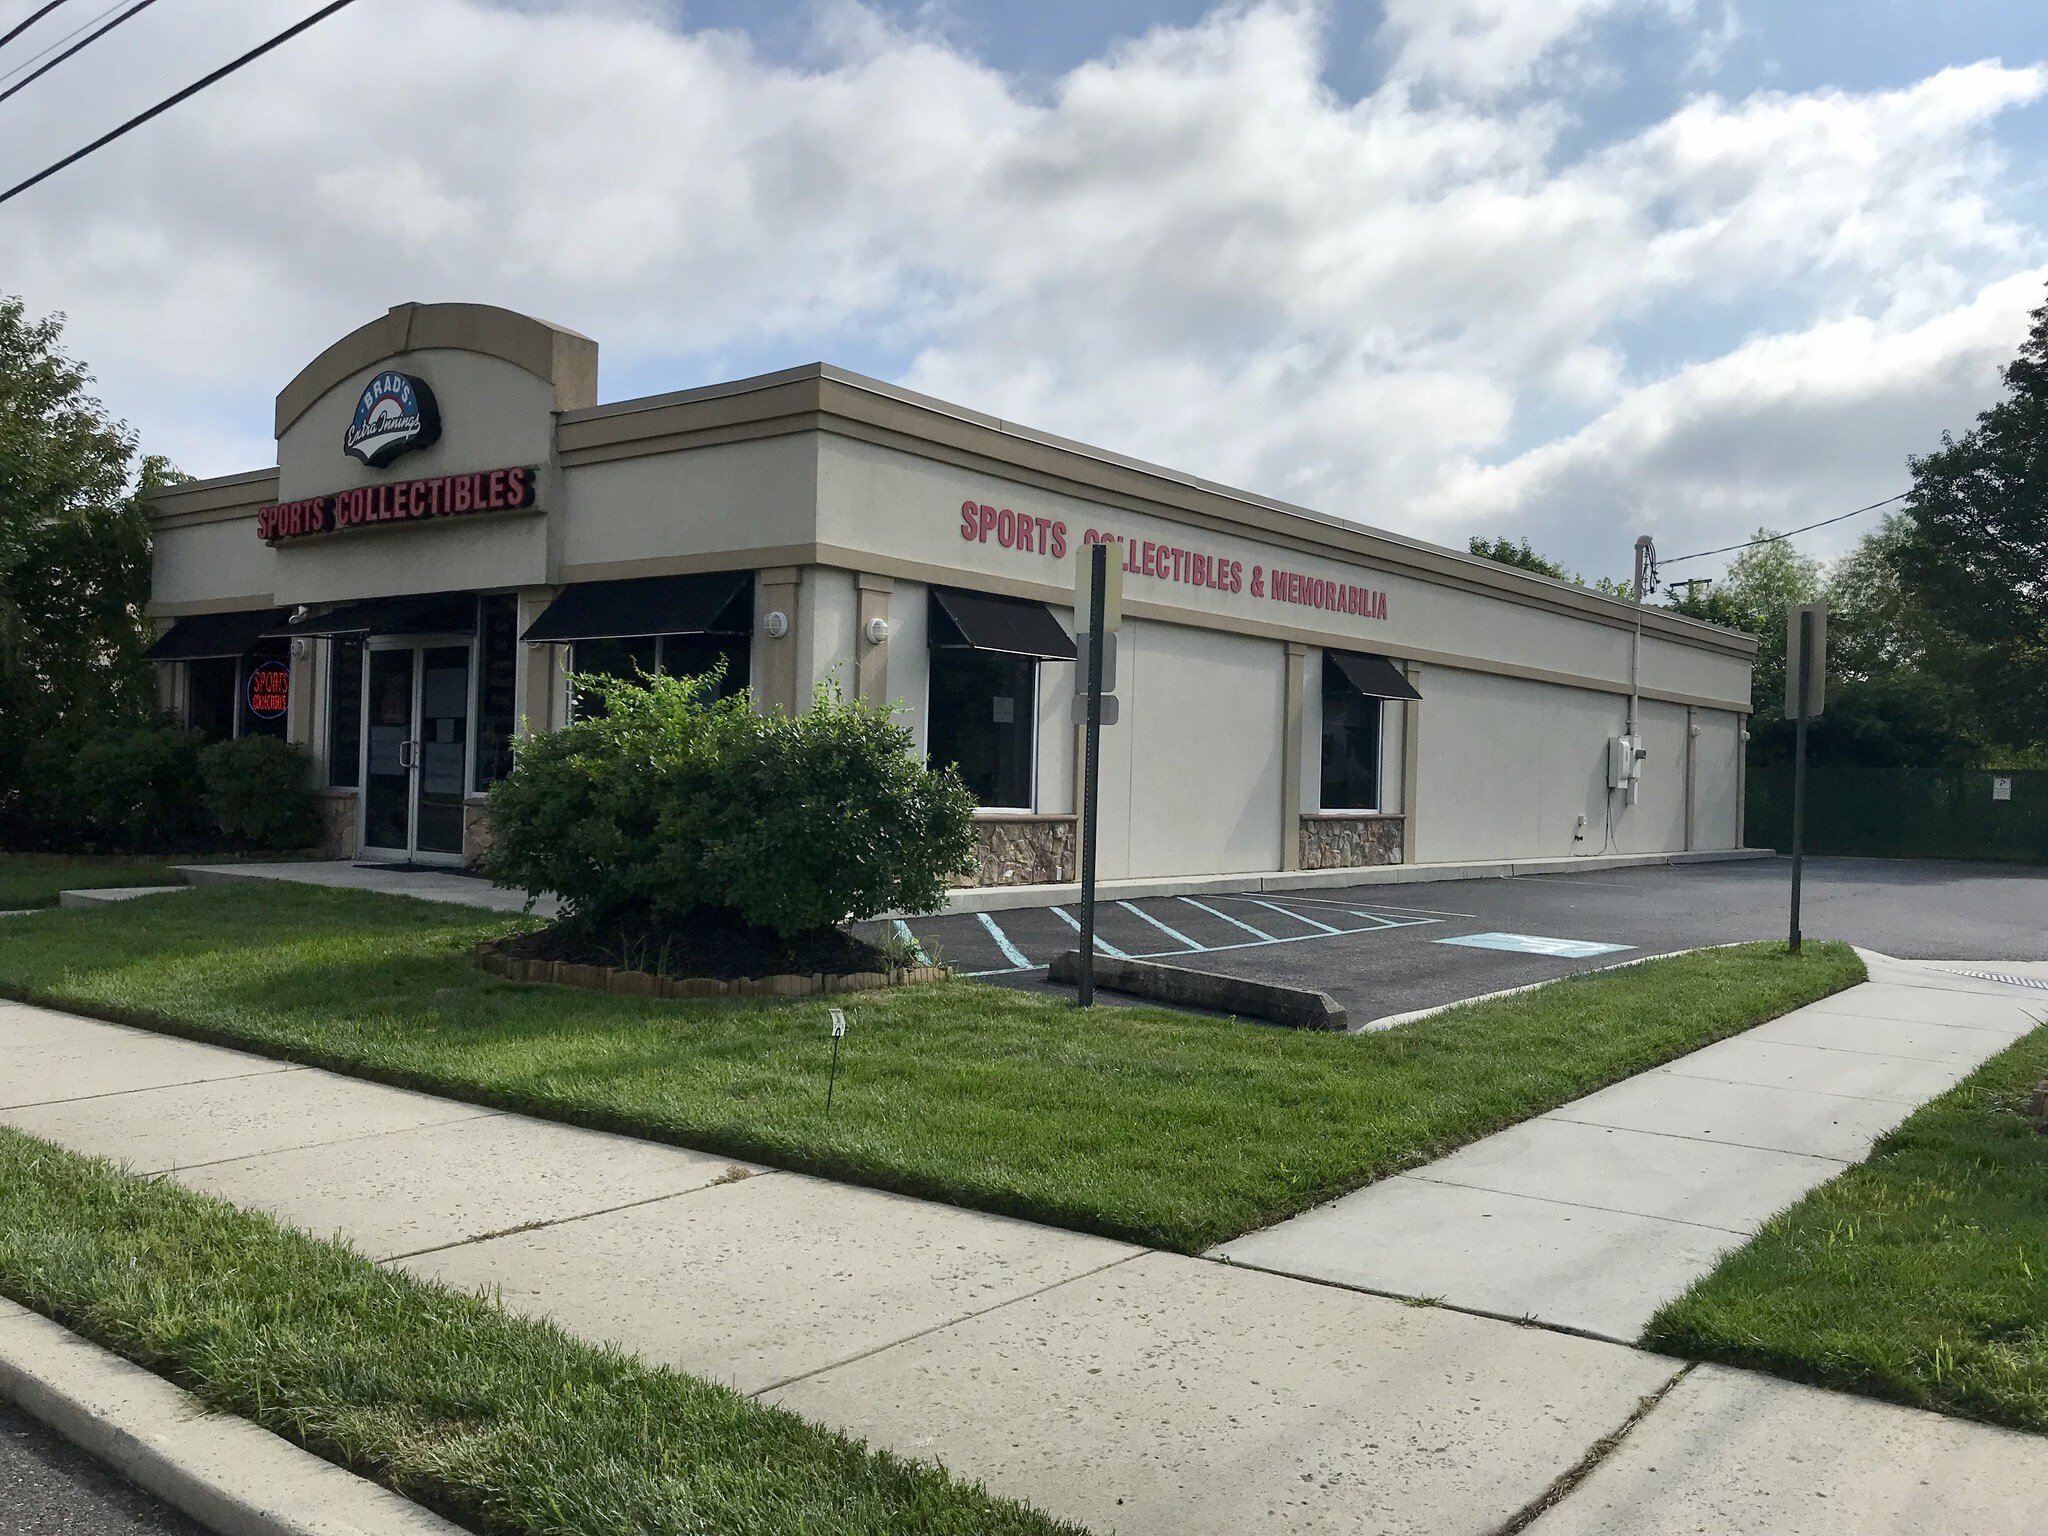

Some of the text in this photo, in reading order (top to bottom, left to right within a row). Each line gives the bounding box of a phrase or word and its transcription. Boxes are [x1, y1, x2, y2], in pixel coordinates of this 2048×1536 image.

[364, 376, 410, 409] BRAD'S
[347, 411, 420, 447] Extra Innings
[257, 467, 526, 540] SPORTS COLLECTIBLES
[961, 501, 1067, 559] SPORTS
[1251, 565, 1265, 598] &
[1272, 570, 1388, 621] MEMORABILIA
[253, 671, 289, 692] SPORTS
